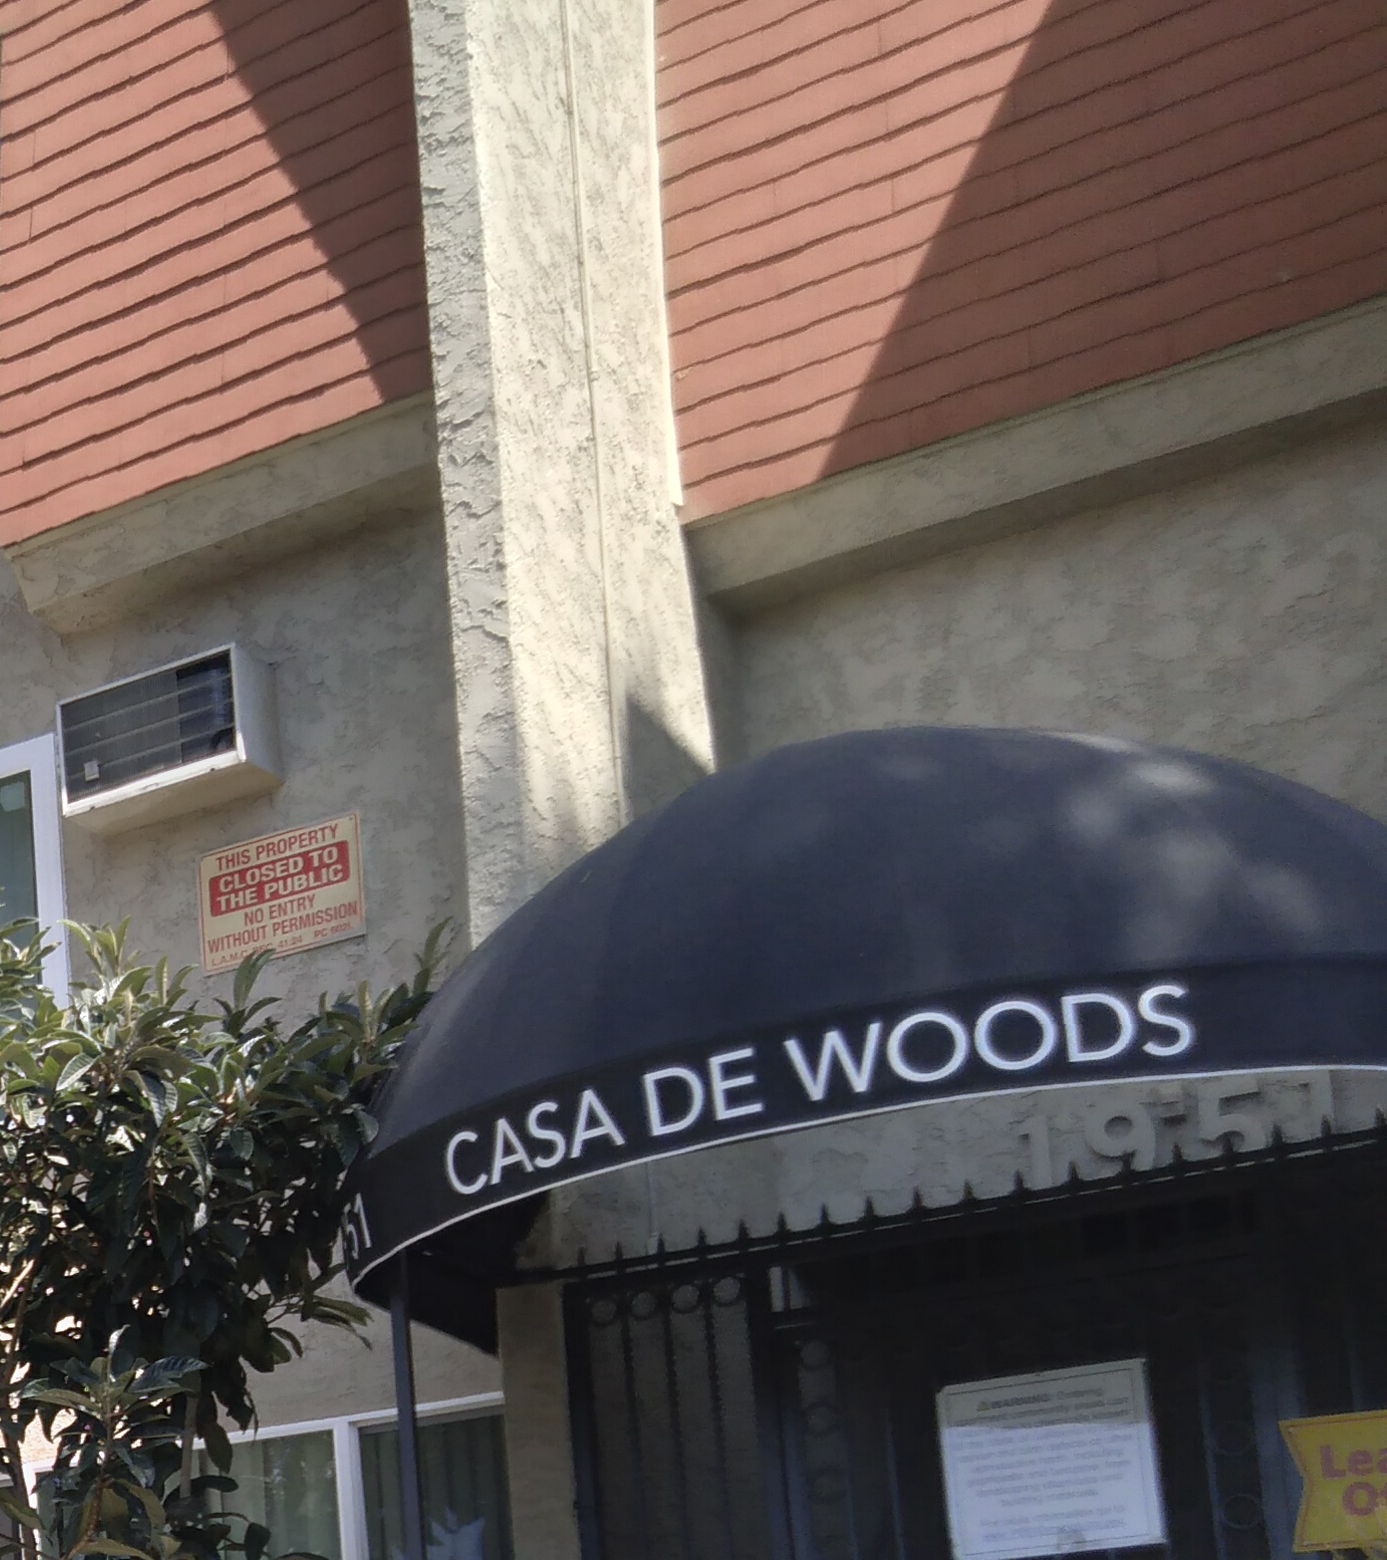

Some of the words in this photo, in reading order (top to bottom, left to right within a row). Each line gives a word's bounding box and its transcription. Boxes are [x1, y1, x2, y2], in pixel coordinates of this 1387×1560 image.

[216, 849, 251, 872] THIS
[255, 823, 338, 861] PROPERTY
[219, 856, 304, 893] CLOSED
[309, 847, 339, 867] TO
[216, 887, 258, 913] THE
[264, 864, 343, 901] PUBLIC
[243, 907, 264, 927] NO
[269, 893, 316, 920] ENTRY
[208, 925, 268, 954] WITHOUT
[272, 901, 358, 937] PERMISSION
[314, 927, 328, 939] PC
[444, 1089, 625, 1196] CASA
[641, 1047, 764, 1139] DE
[783, 983, 1195, 1103] WOODS
